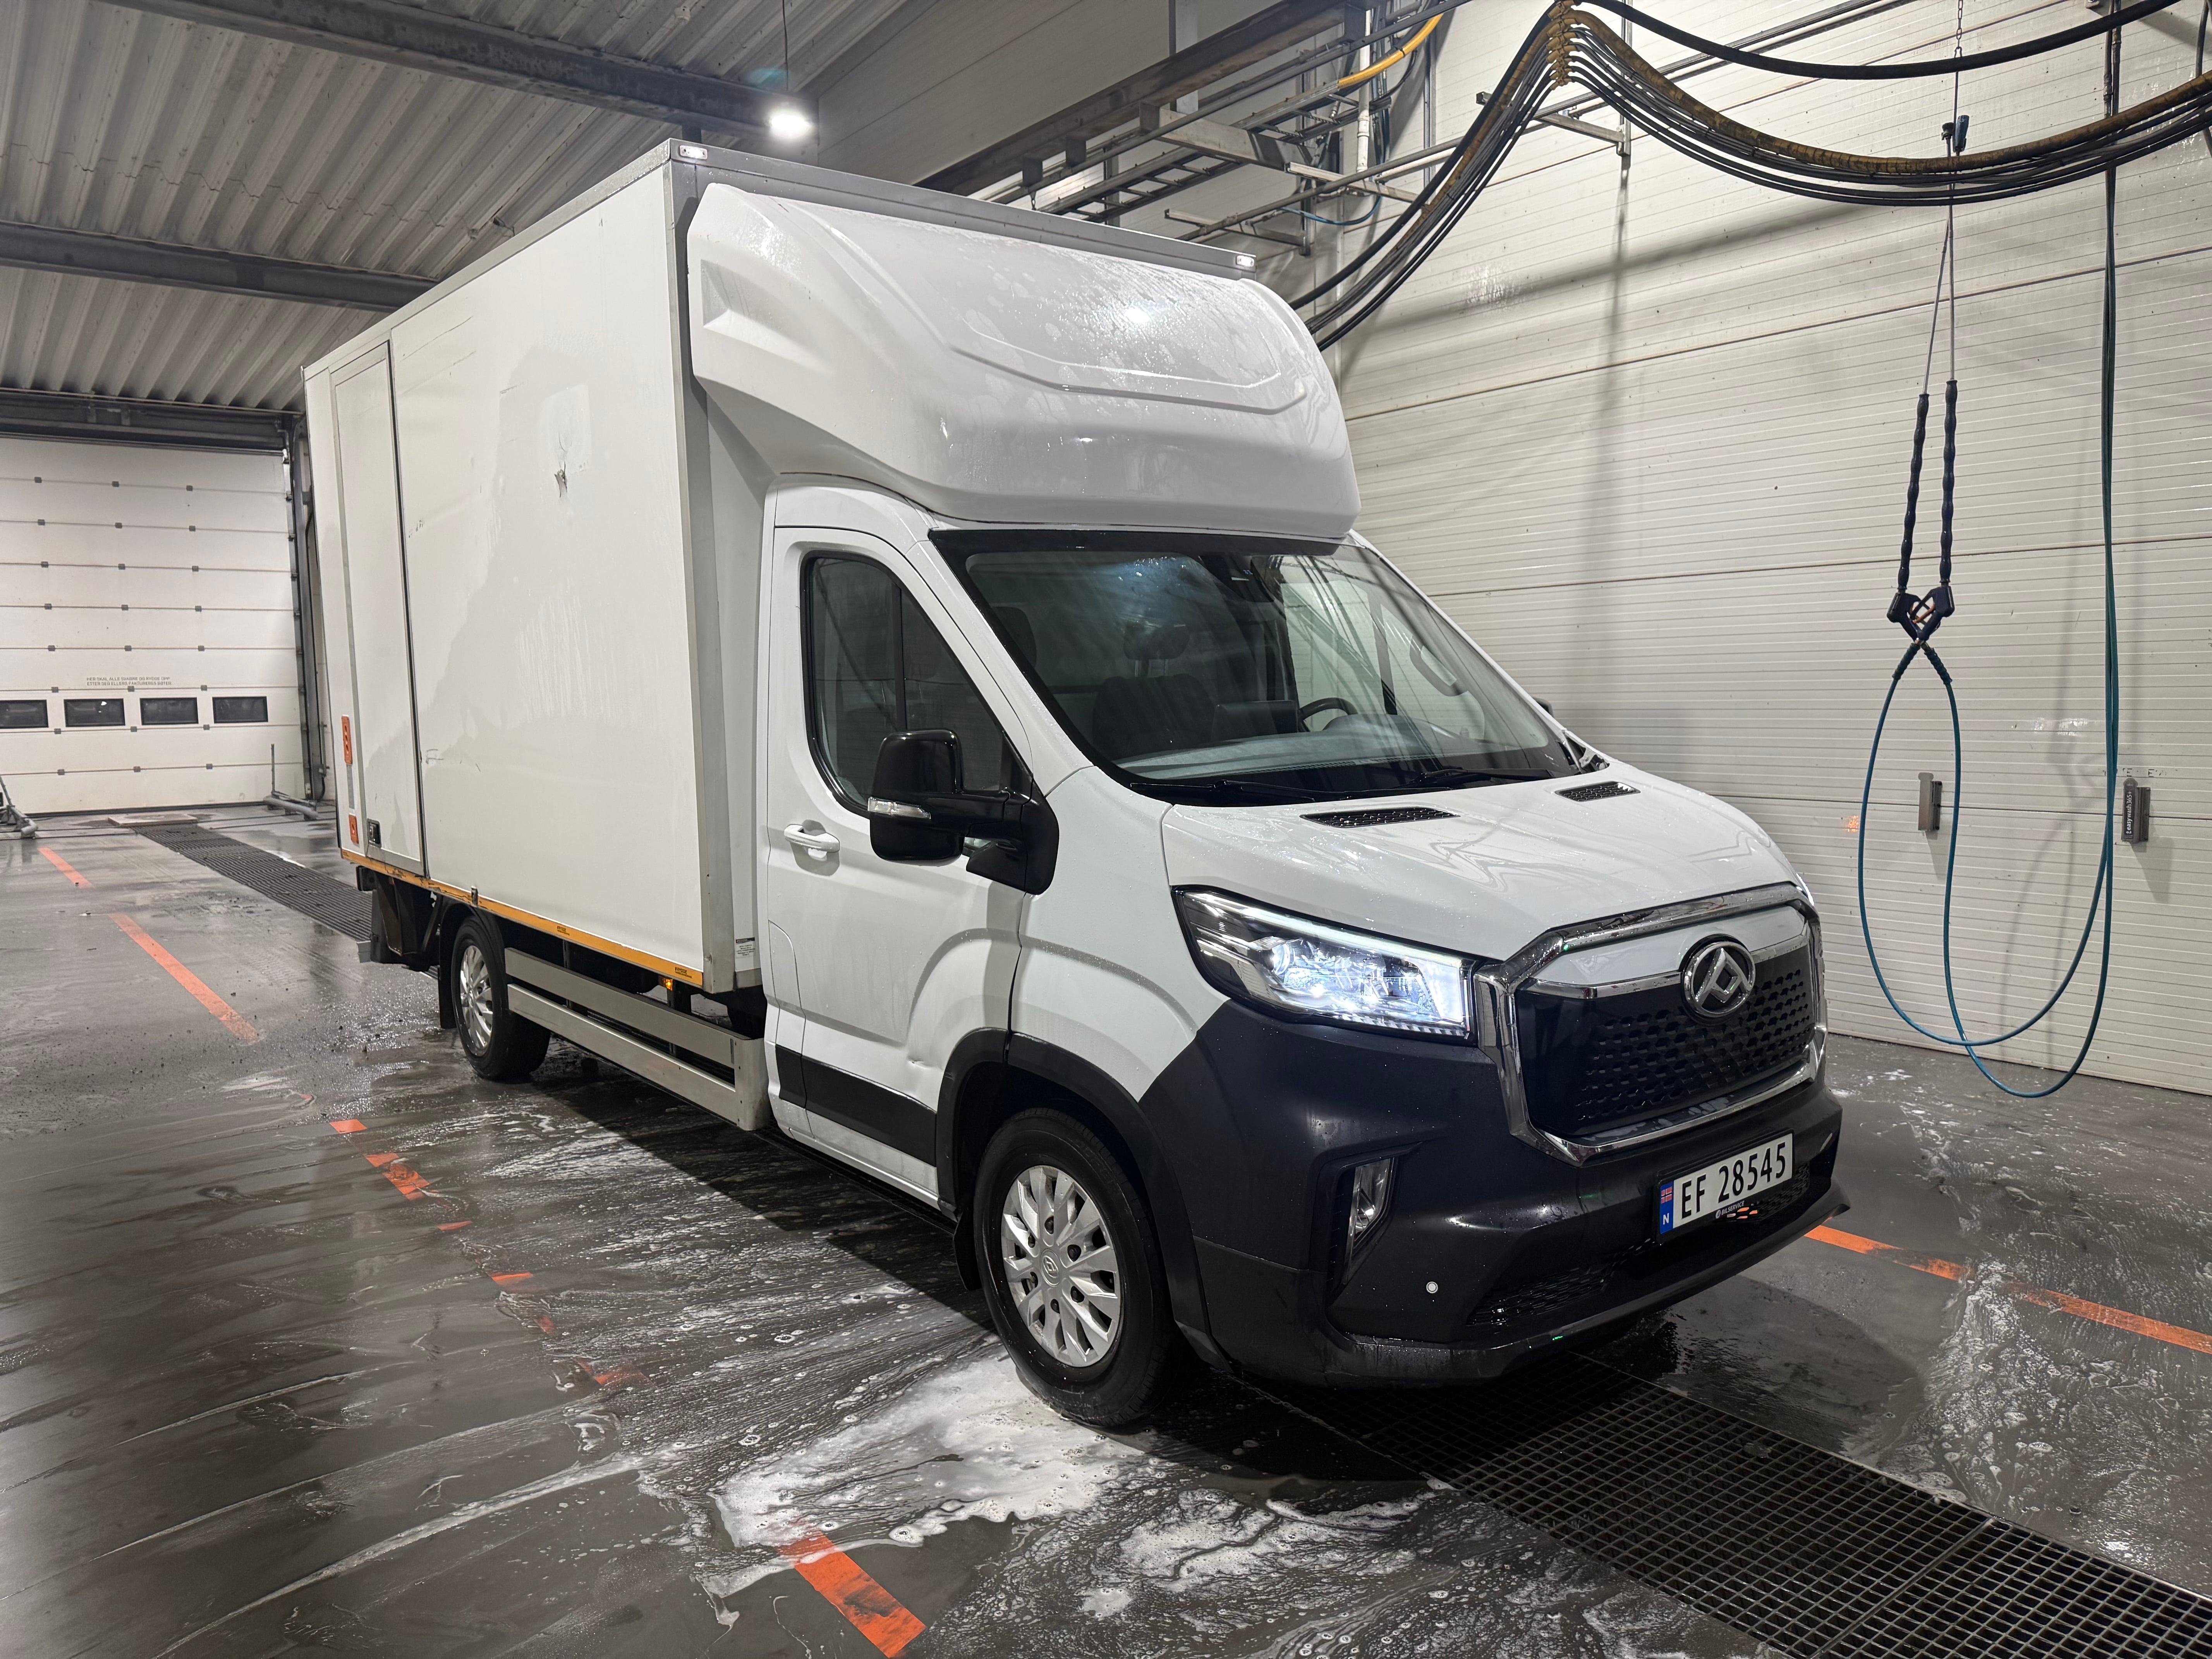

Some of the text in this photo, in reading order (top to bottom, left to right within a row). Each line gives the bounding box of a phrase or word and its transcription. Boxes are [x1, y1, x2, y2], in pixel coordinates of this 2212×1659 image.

[1681, 1142, 1786, 1219] EF 28545
[1721, 1200, 1745, 1216] BILSERVICE
[1662, 1212, 1669, 1225] N
